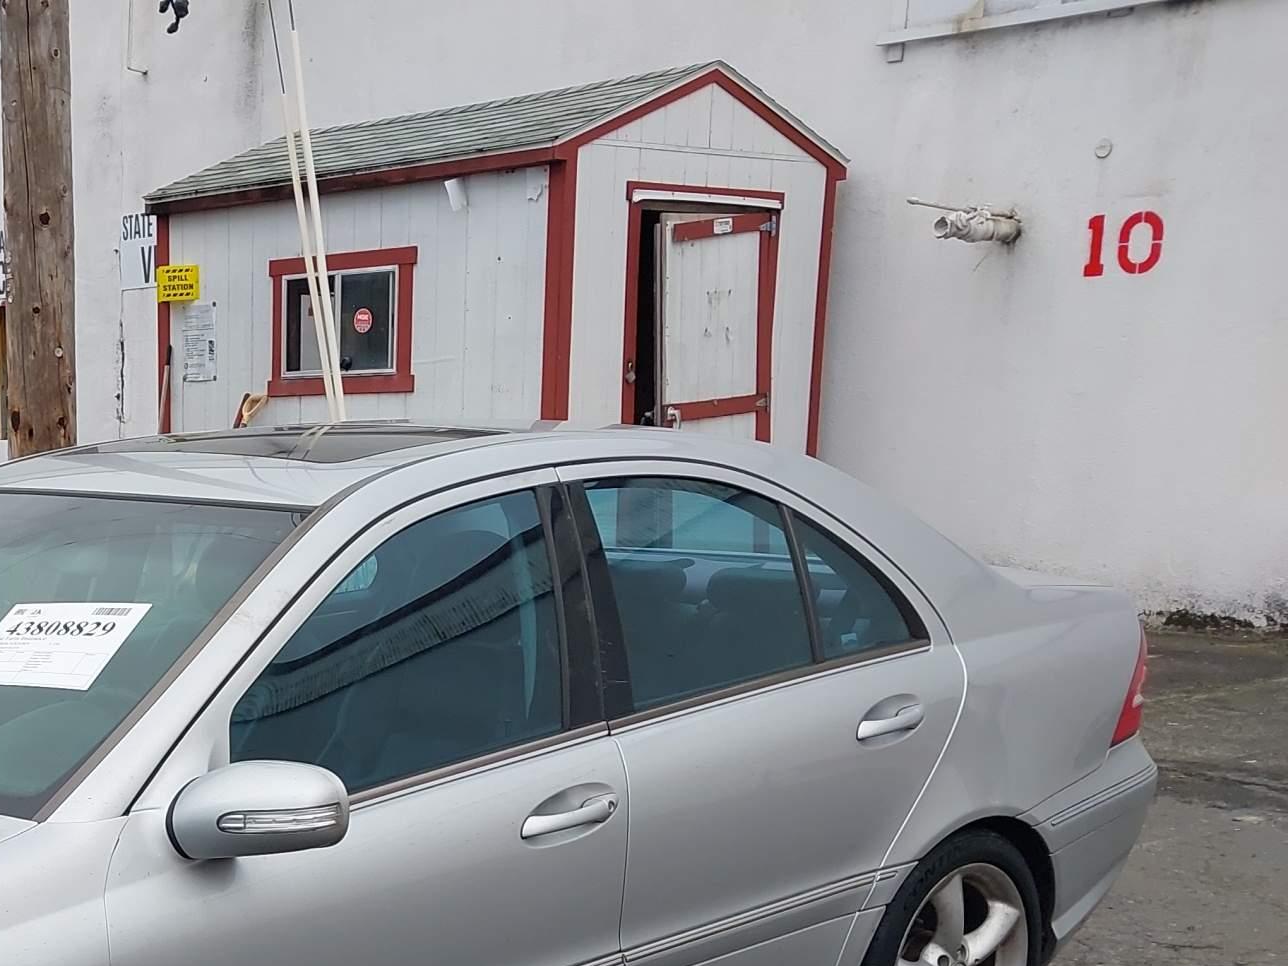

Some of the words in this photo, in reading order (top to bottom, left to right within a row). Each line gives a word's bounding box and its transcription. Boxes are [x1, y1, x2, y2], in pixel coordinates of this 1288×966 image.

[122, 212, 153, 241] STATE
[1083, 210, 1164, 277] 10
[141, 245, 157, 283] VI
[162, 283, 194, 292] STATION
[167, 274, 189, 282] SPILL
[5, 620, 116, 638] 43808829
